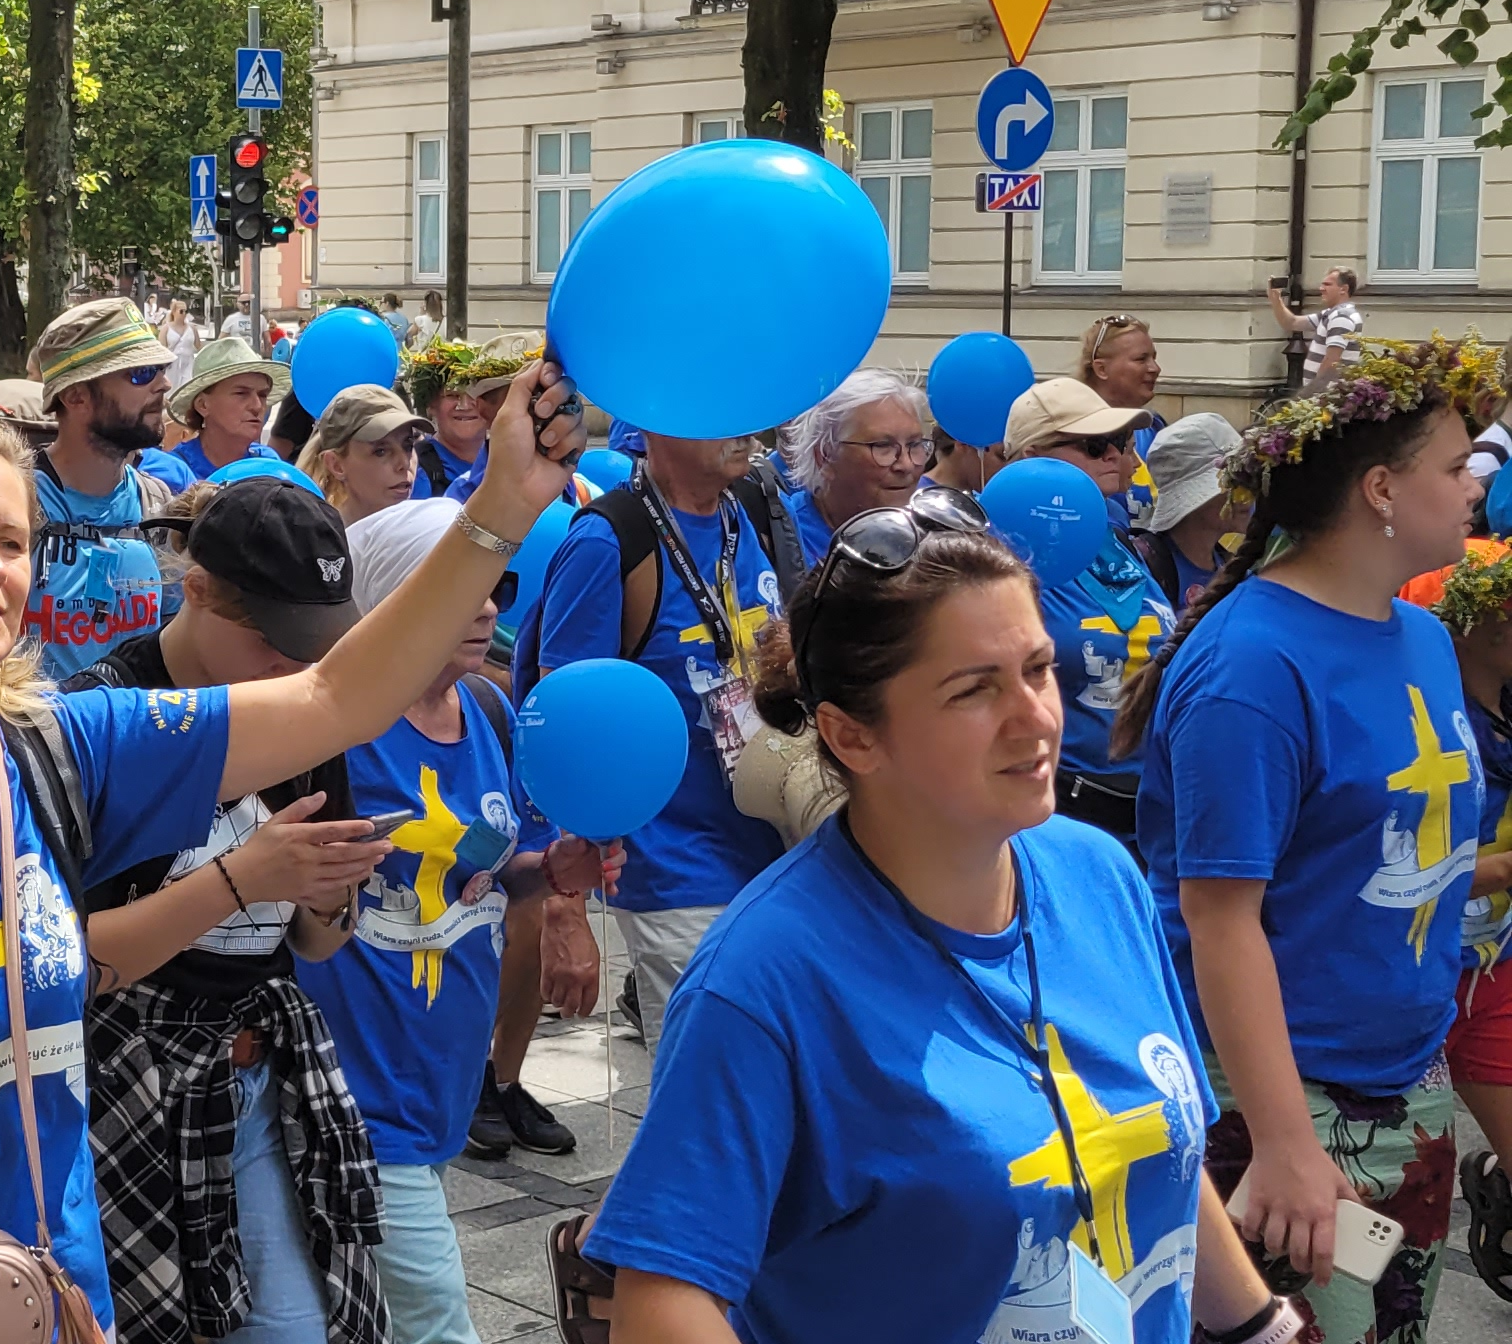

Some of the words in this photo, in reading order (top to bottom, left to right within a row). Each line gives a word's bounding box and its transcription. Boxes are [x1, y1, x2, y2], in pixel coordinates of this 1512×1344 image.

[990, 177, 1040, 207] TAXI
[159, 691, 186, 705] 4
[178, 714, 195, 733] NIE
[373, 929, 396, 944] Wiara
[49, 1044, 63, 1057] że
[1011, 1327, 1051, 1343] Wiara
[1054, 1326, 1083, 1341] czyn
